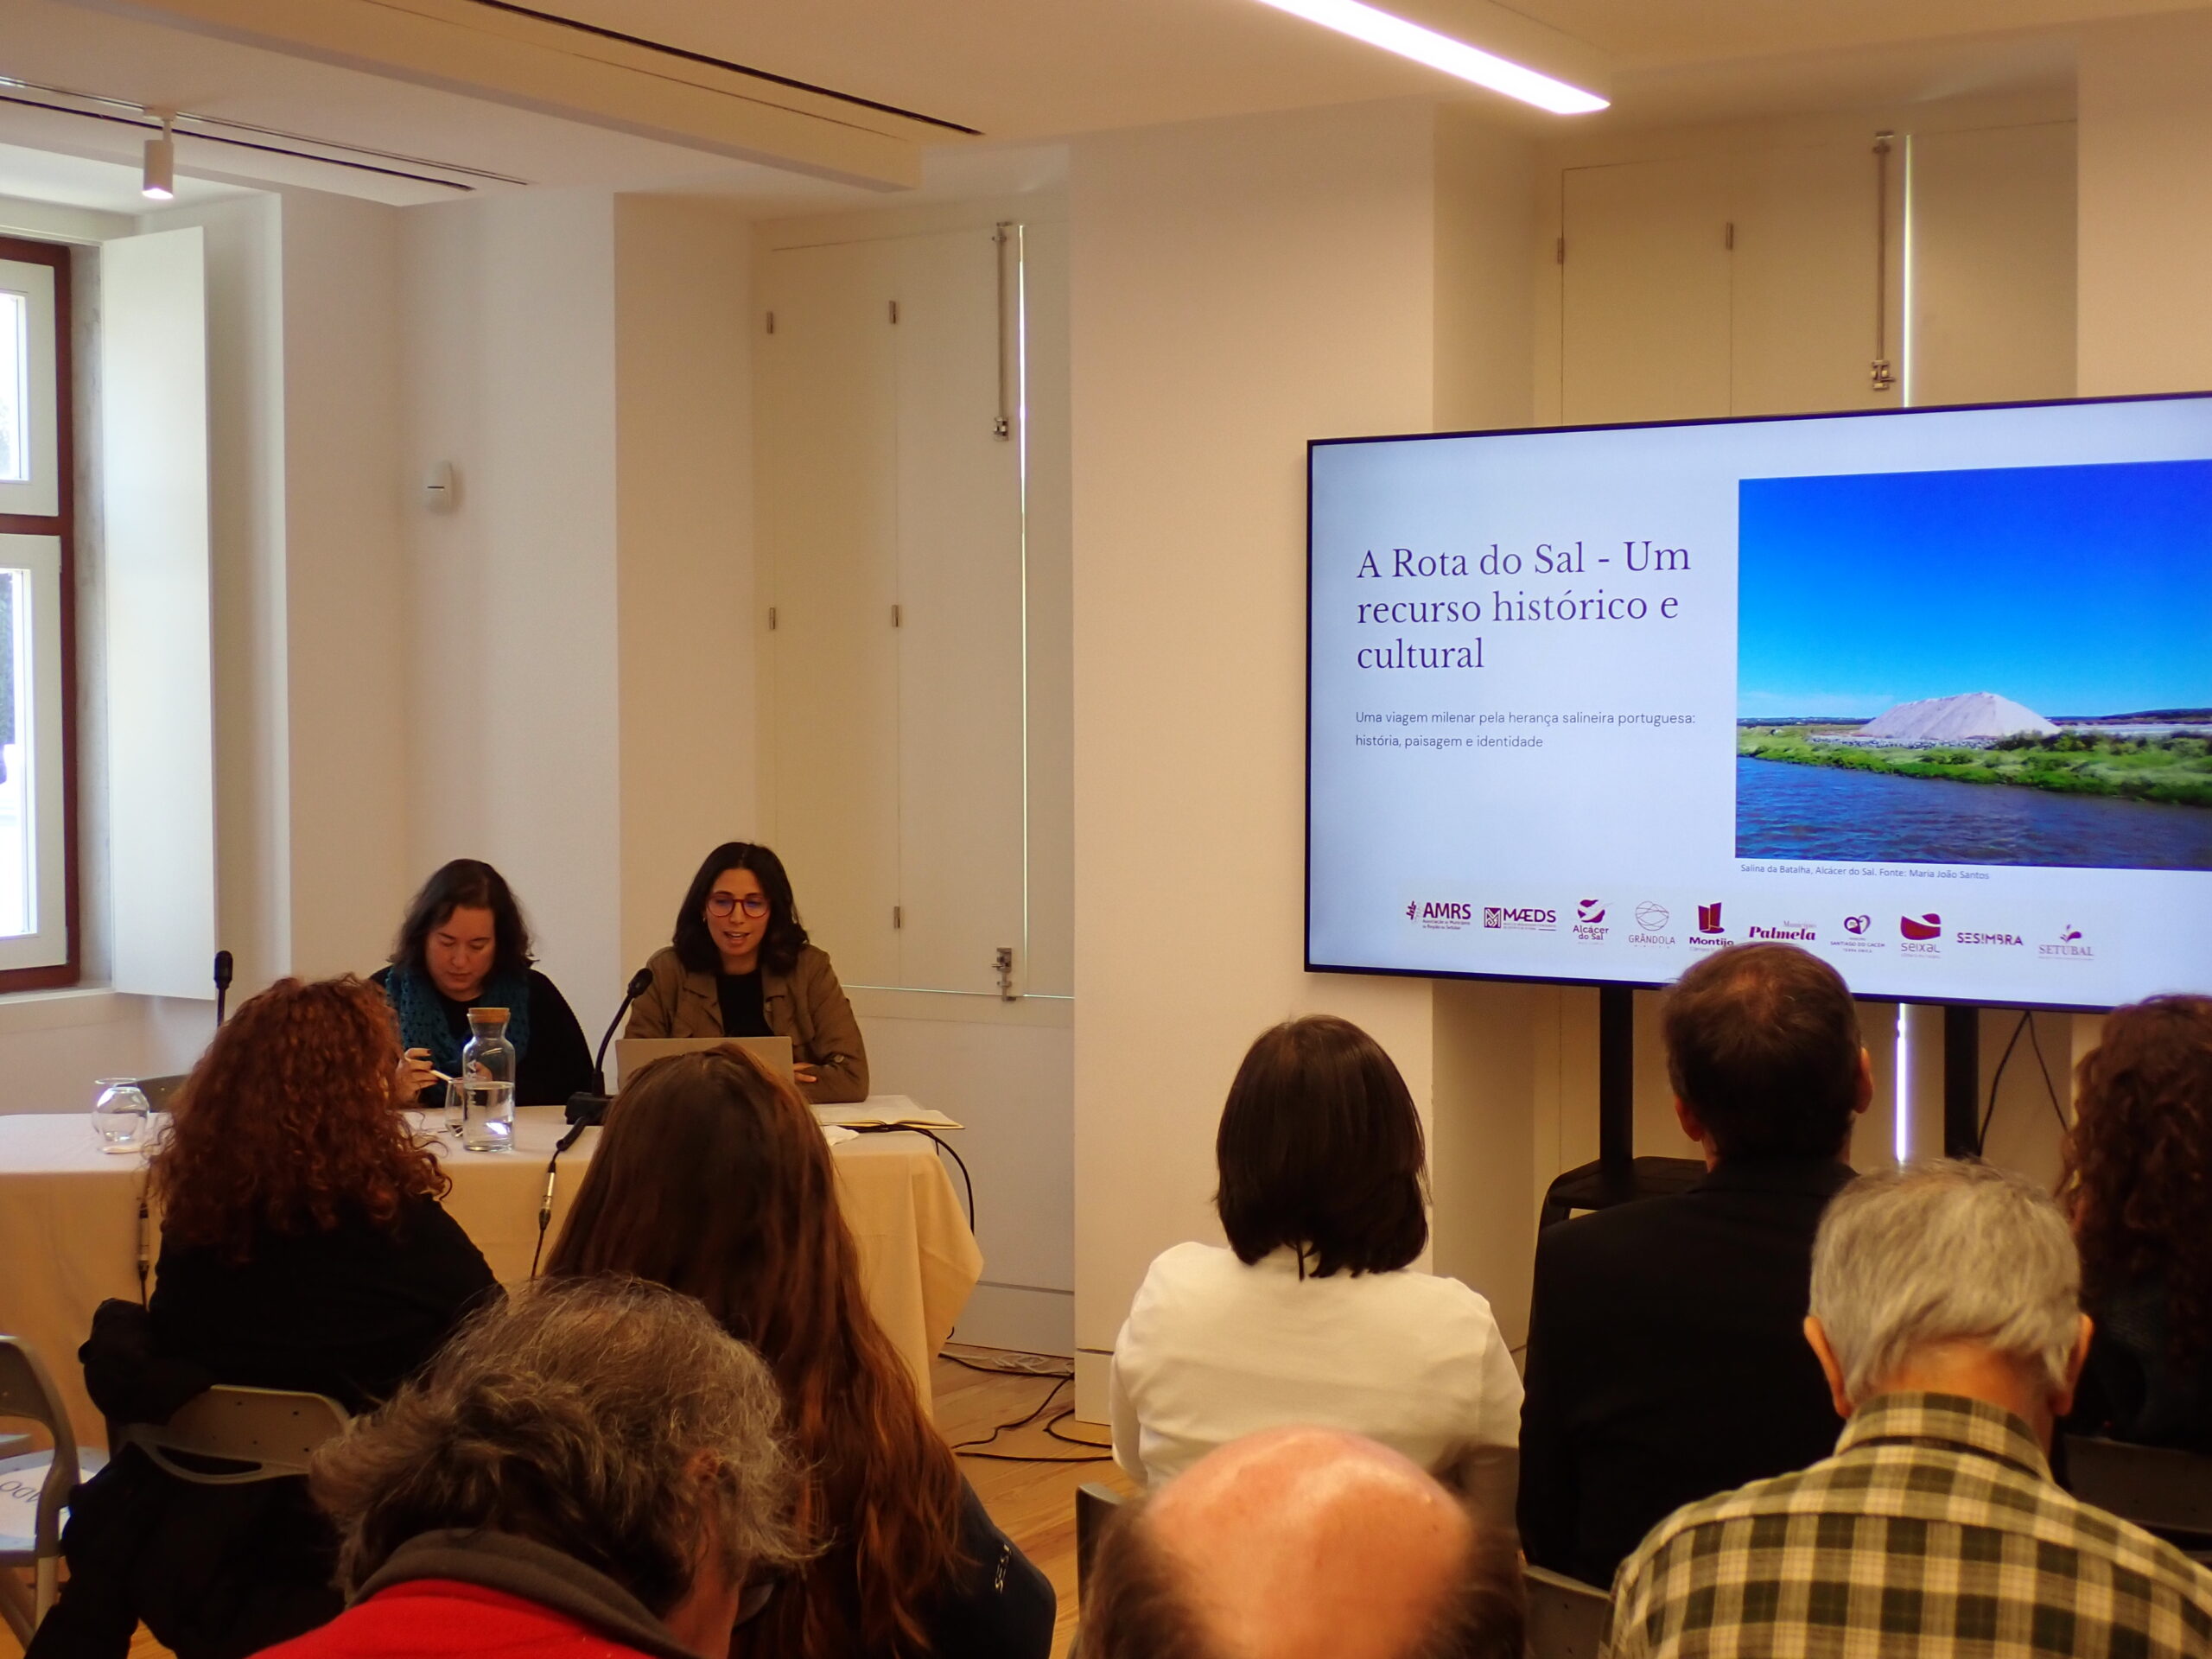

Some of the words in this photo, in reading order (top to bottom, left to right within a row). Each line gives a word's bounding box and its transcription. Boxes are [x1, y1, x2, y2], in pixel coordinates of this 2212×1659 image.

[1357, 550, 1382, 578] A
[1392, 549, 1468, 577] Rota
[1480, 544, 1522, 575] do
[1535, 542, 1585, 574] Sal
[1624, 541, 1691, 571] Um
[1357, 598, 1481, 624] recurso
[1492, 589, 1647, 621] histórico
[1661, 596, 1678, 619] e
[1357, 638, 1484, 668] cultural
[1355, 711, 1382, 722] Uma
[1385, 711, 1428, 726] viagem
[1431, 711, 1475, 722] milenar
[1479, 711, 1505, 726] pela
[1509, 711, 1559, 727] herança
[1562, 711, 1615, 723] salineira
[1618, 713, 1696, 727] portuguesa:
[1355, 734, 1402, 747] história,
[1404, 735, 1463, 749] paisagem
[1477, 735, 1544, 747] identidade
[1767, 864, 1777, 873] da
[1779, 865, 1814, 874] Batalha,
[1848, 867, 1860, 875] do
[1879, 868, 1907, 876] Fonte:
[1909, 868, 1935, 878] Maria
[1936, 869, 1957, 878] João
[1959, 870, 1990, 879] Santos
[1422, 902, 1471, 919] AMRS
[1572, 925, 1610, 934] Alcácer
[1591, 931, 1604, 940] Sal
[1748, 925, 1816, 940] Palmela
[1628, 933, 1675, 944] GRÂNDOLA
[1688, 937, 1735, 946] Montijo
